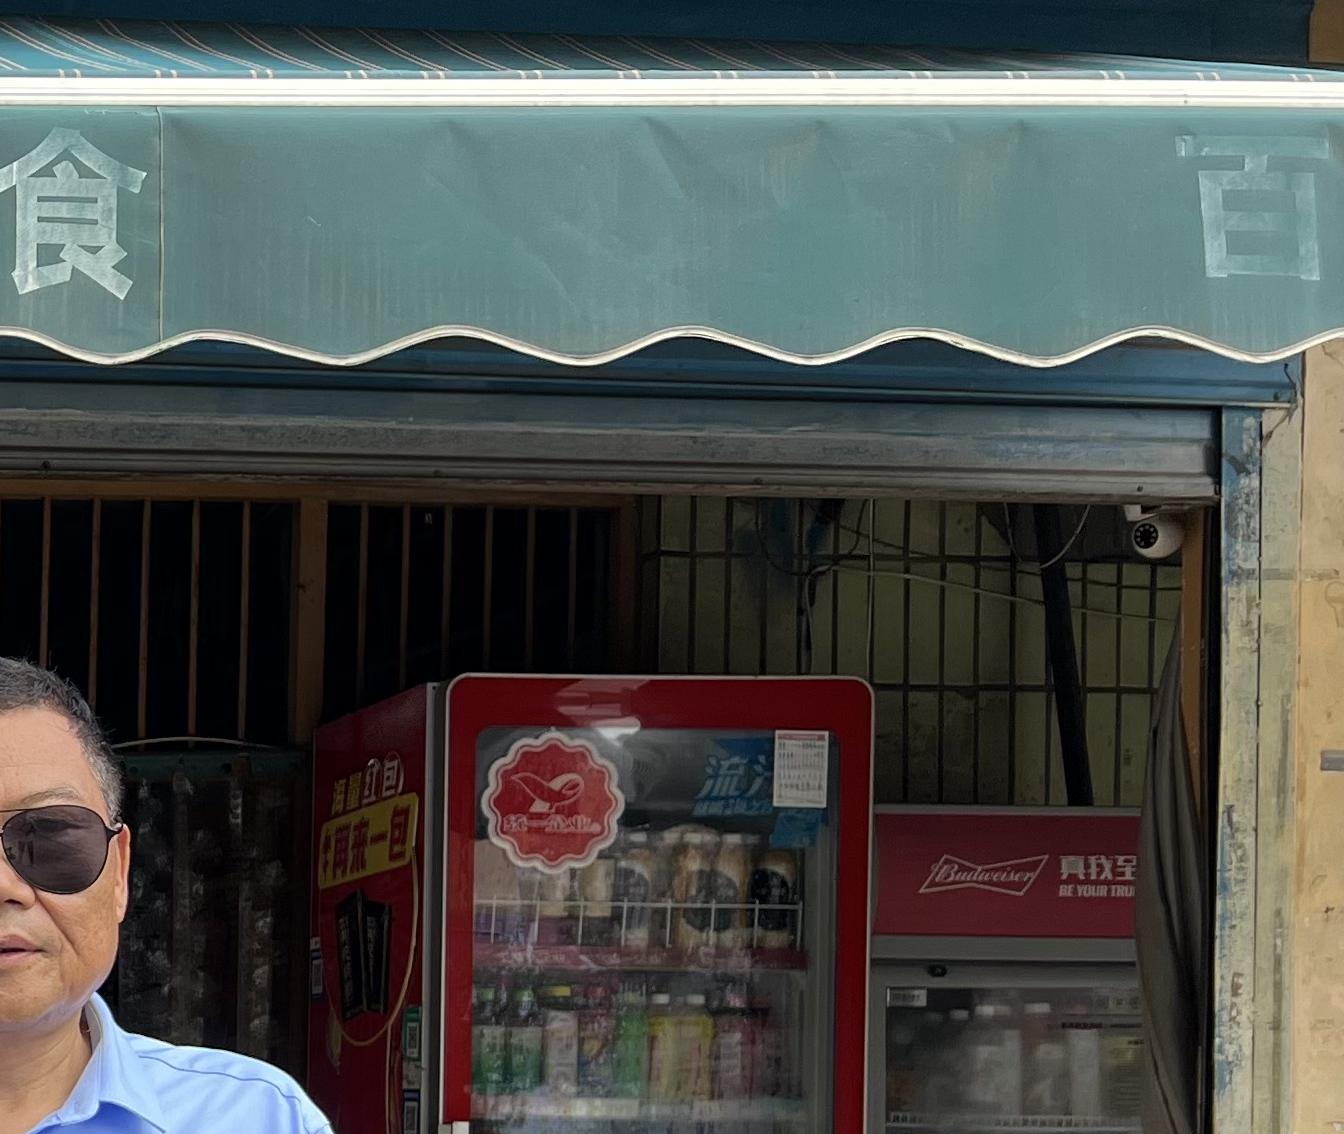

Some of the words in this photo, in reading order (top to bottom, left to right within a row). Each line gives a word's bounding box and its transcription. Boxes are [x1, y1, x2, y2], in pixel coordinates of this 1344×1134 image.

[930, 863, 1036, 882] Budweiser
[1059, 885, 1074, 898] BE
[1076, 885, 1108, 898] YOUR
